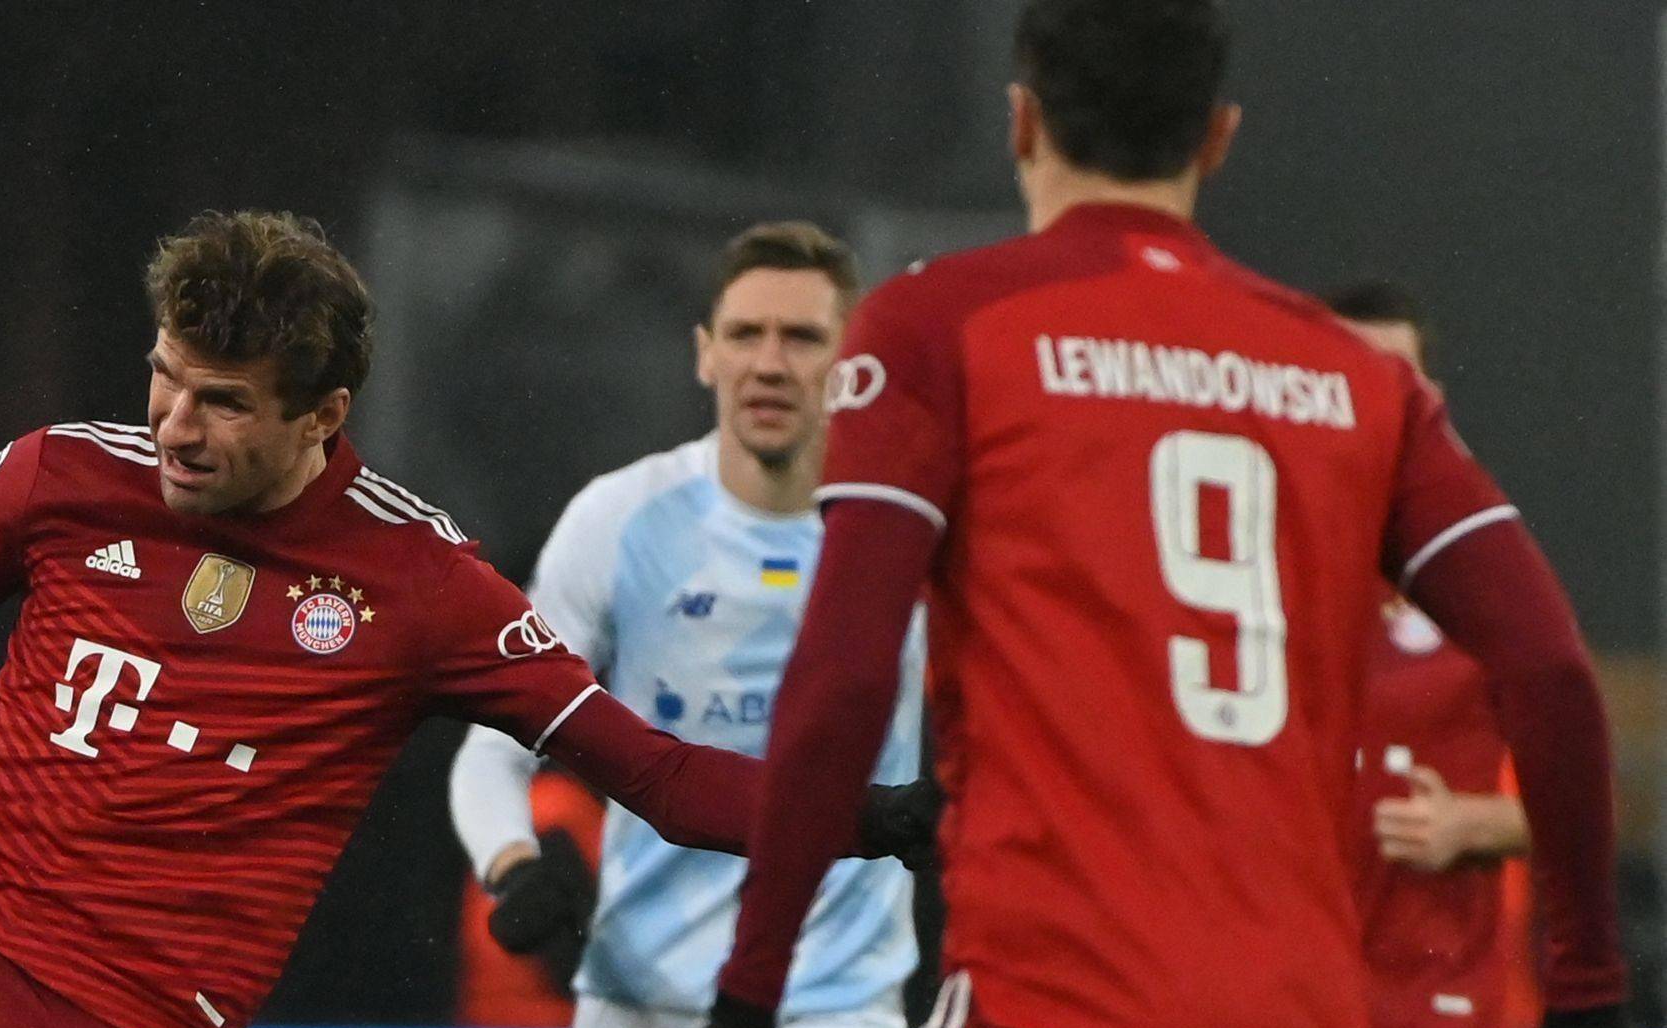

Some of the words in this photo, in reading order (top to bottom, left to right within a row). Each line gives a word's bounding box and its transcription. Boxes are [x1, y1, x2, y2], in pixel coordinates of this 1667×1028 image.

[1035, 333, 1357, 430] LEWANDOWSKI
[85, 554, 141, 579] adidas
[1148, 429, 1290, 747] 9
[197, 601, 223, 617] FIFA
[300, 600, 316, 614] FC
[317, 597, 352, 627] BAYERN
